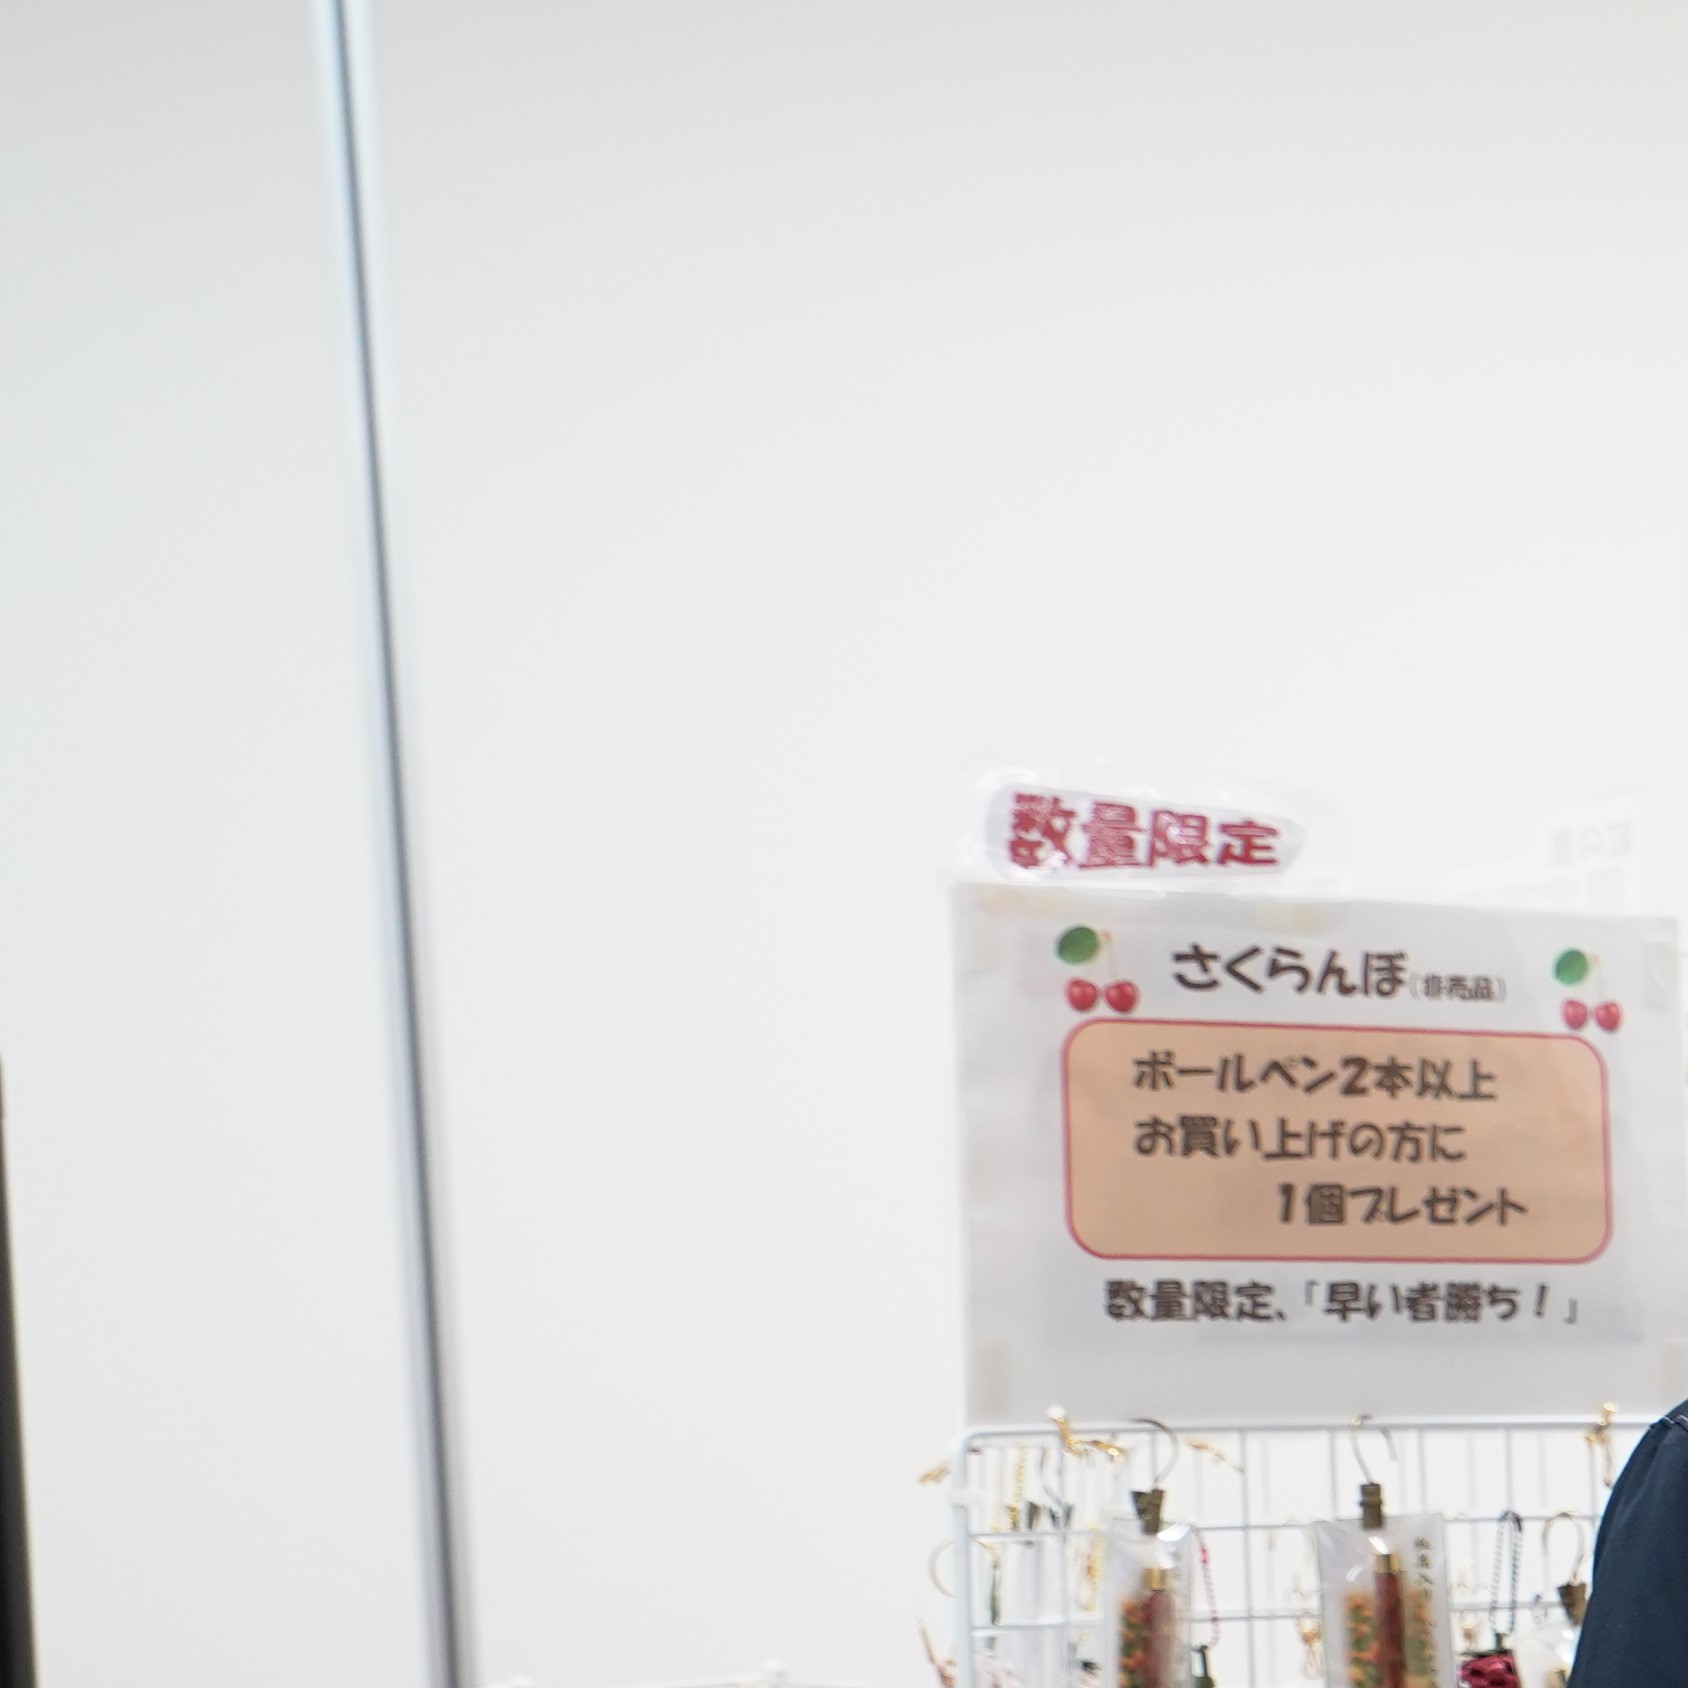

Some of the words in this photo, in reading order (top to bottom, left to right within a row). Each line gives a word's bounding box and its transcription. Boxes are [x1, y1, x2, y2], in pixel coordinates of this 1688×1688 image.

[1008, 792, 1281, 871] 数量限定
[1132, 1055, 1498, 1103] ボールペン2本以上
[1134, 1117, 1466, 1164] お買い上げの方に
[1279, 1186, 1527, 1228] 1個プレゼント
